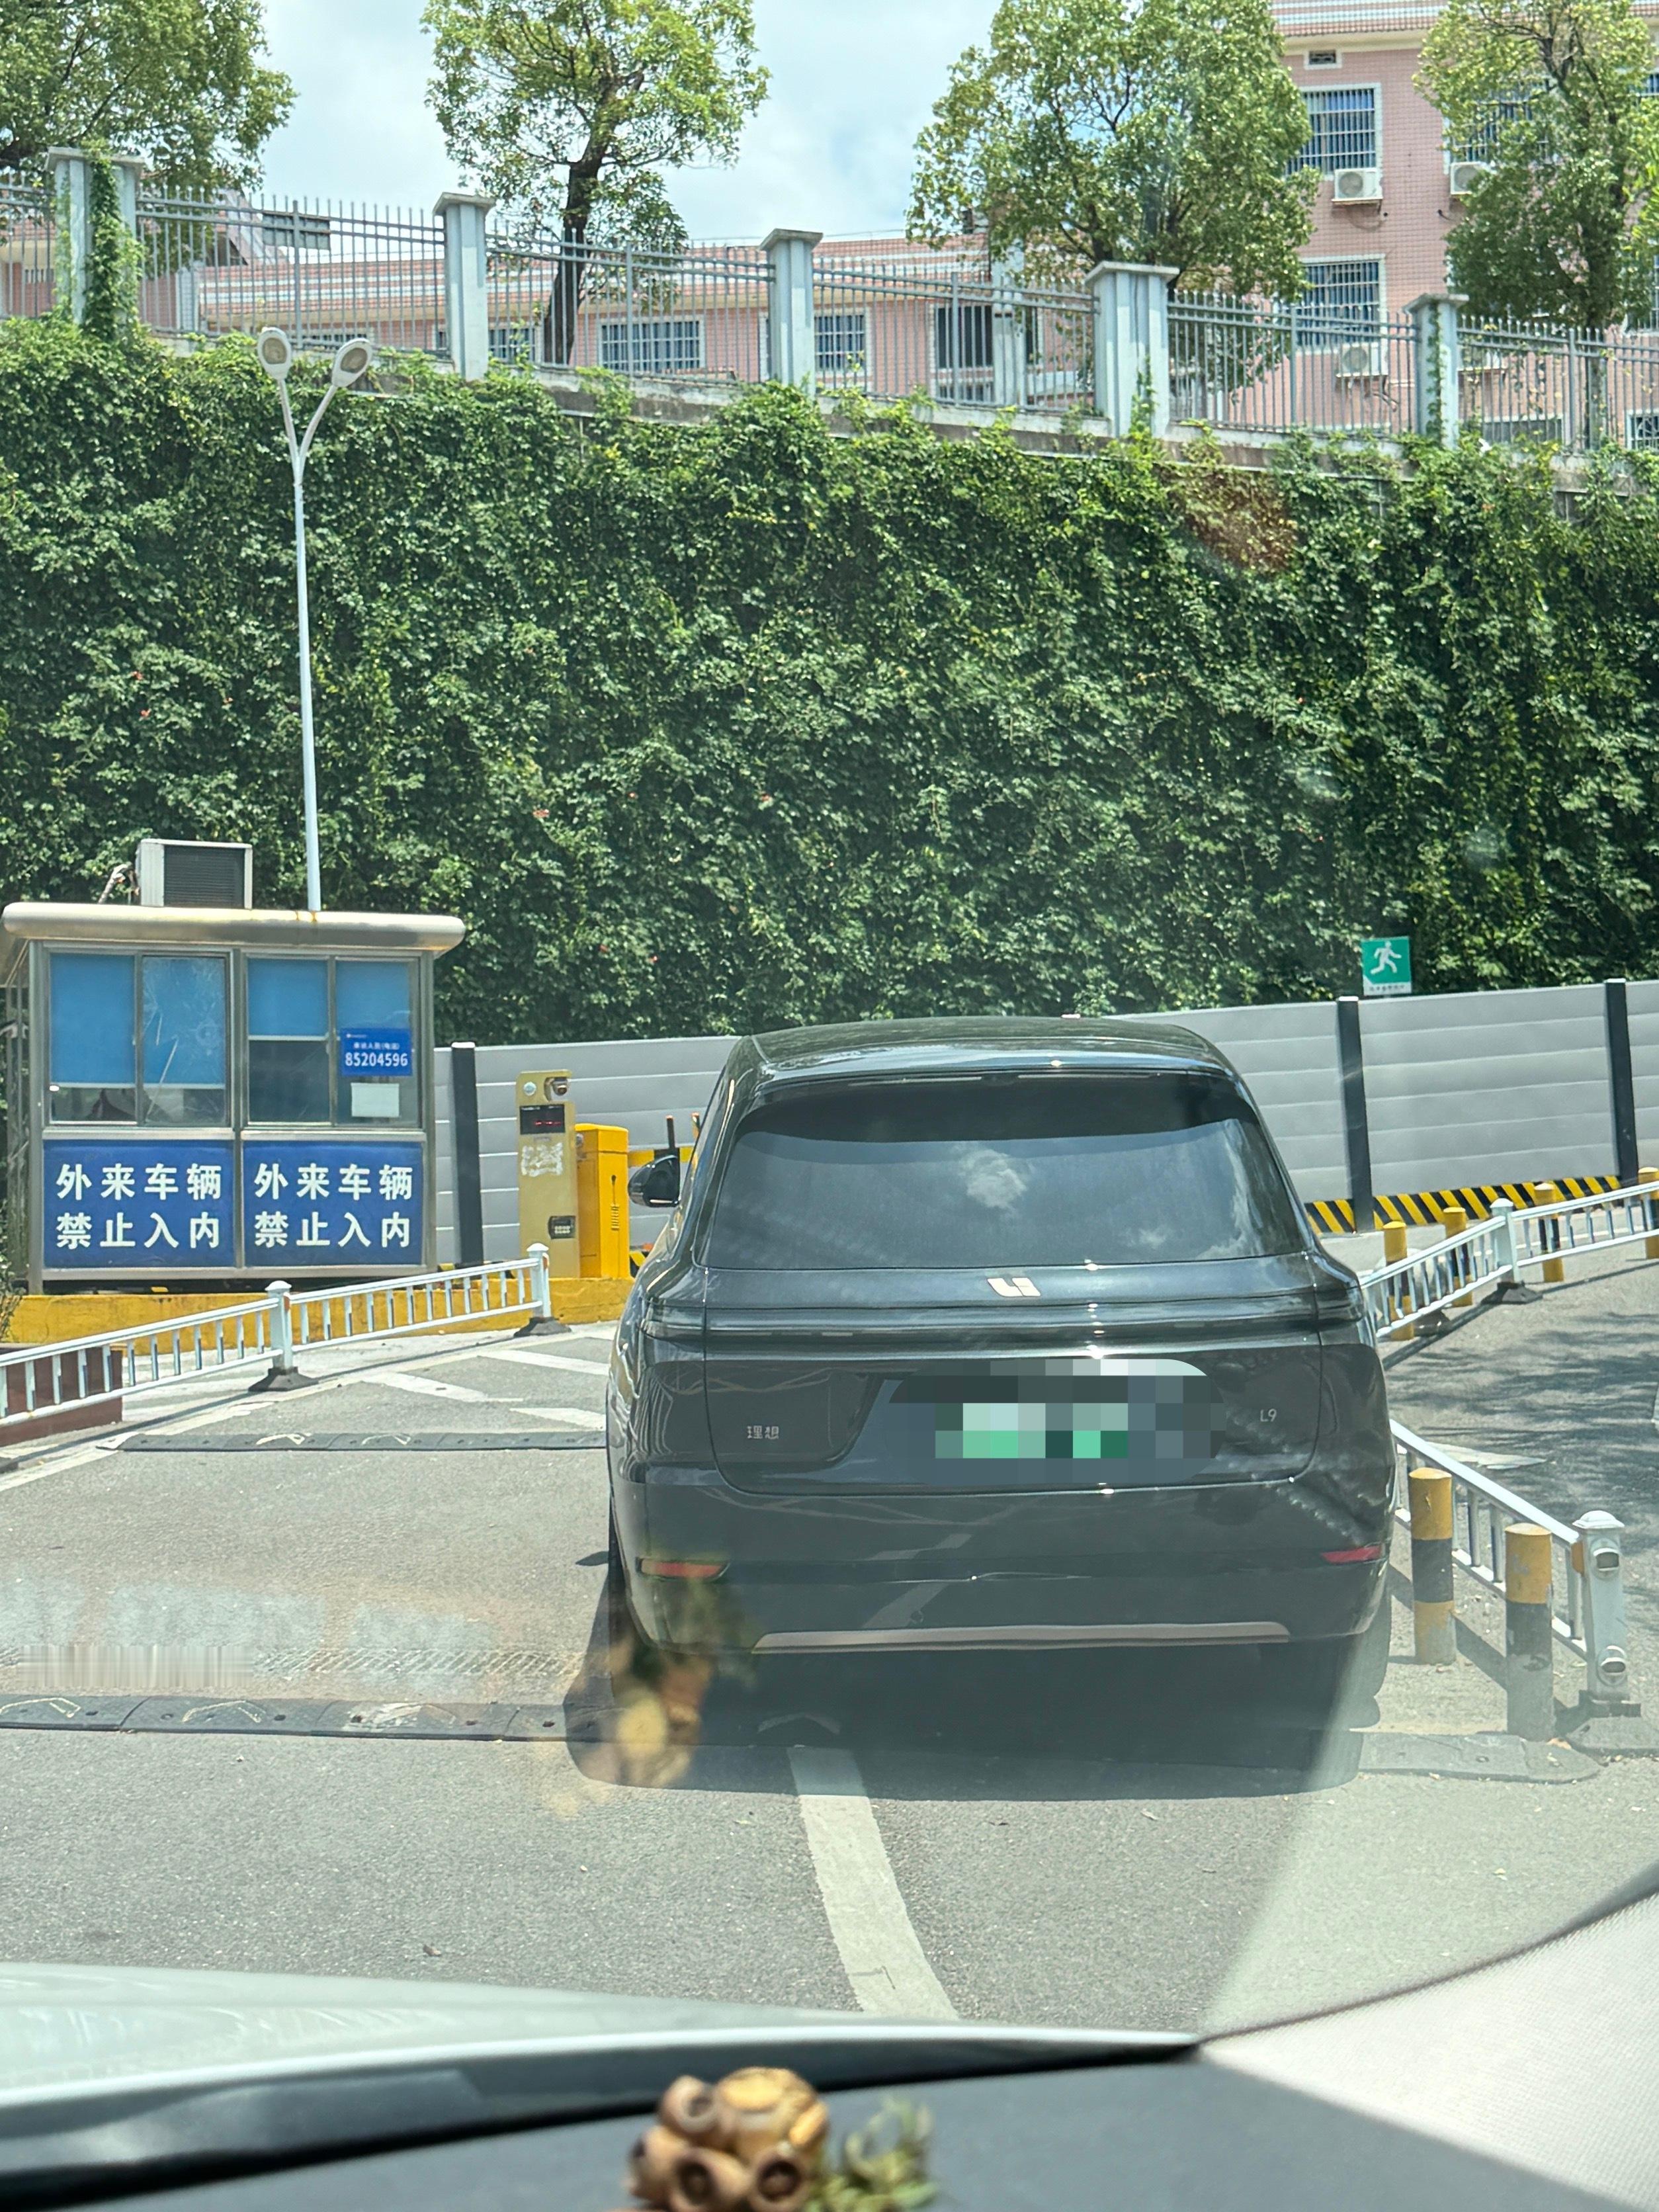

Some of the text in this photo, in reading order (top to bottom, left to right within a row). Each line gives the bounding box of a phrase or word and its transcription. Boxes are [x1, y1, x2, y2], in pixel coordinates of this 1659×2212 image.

[345, 1052, 409, 1067] 85204596
[56, 1163, 222, 1201] 外来车辆
[254, 1163, 413, 1201] 外来车辆
[56, 1211, 220, 1250] 禁止入内
[254, 1211, 410, 1248] 禁止入内
[747, 1425, 779, 1439] 理想
[1259, 1408, 1277, 1422] L9
